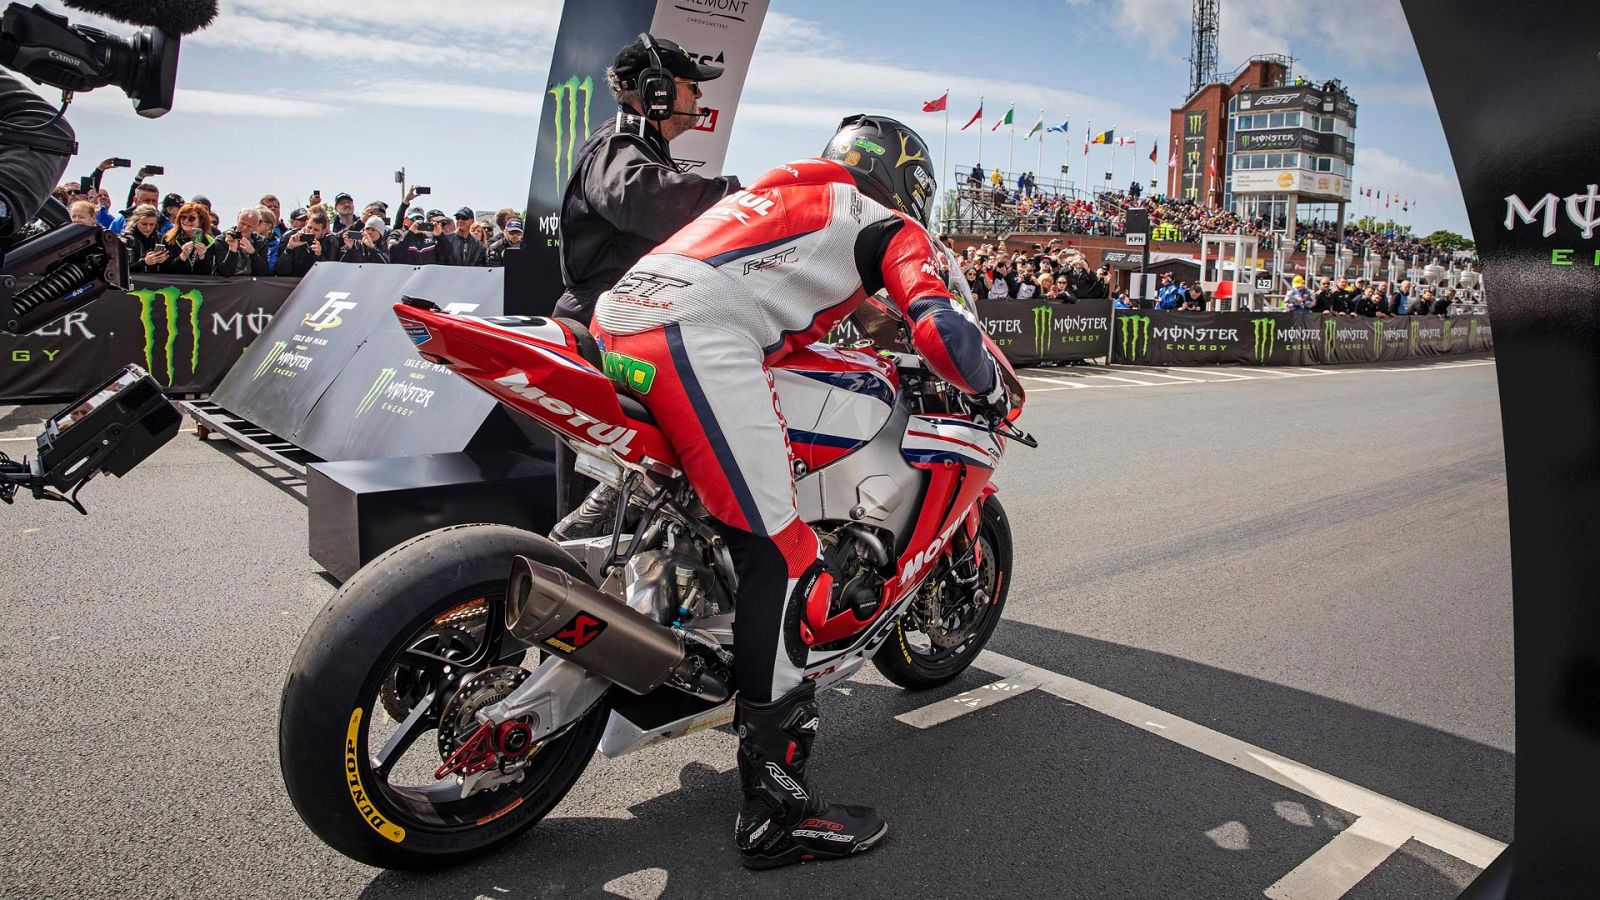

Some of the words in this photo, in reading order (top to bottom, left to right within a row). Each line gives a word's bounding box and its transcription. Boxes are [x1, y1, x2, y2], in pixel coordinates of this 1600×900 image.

[49, 50, 81, 67] Canon
[1254, 93, 1300, 106] RST
[1251, 133, 1294, 143] MONSTER
[743, 247, 797, 276] RST
[1054, 315, 1107, 333] MONSTER
[1062, 335, 1100, 343] ENERGY
[1153, 325, 1239, 342] MONSTER
[1277, 326, 1321, 342] MONSTER
[1336, 327, 1368, 342] MONSTER
[1383, 327, 1408, 341] MONSTER
[1166, 343, 1227, 351] ENERGY
[276, 351, 314, 371] MONSTER
[404, 358, 422, 368] ISLE
[420, 361, 431, 370] OF
[385, 380, 435, 408] MONSTER
[381, 402, 414, 417] ENERGY
[494, 372, 638, 456] MOTUL
[347, 739, 387, 830] DUNLOP
[765, 761, 810, 801] RST
[801, 818, 844, 830] pro
[792, 829, 854, 842] series
